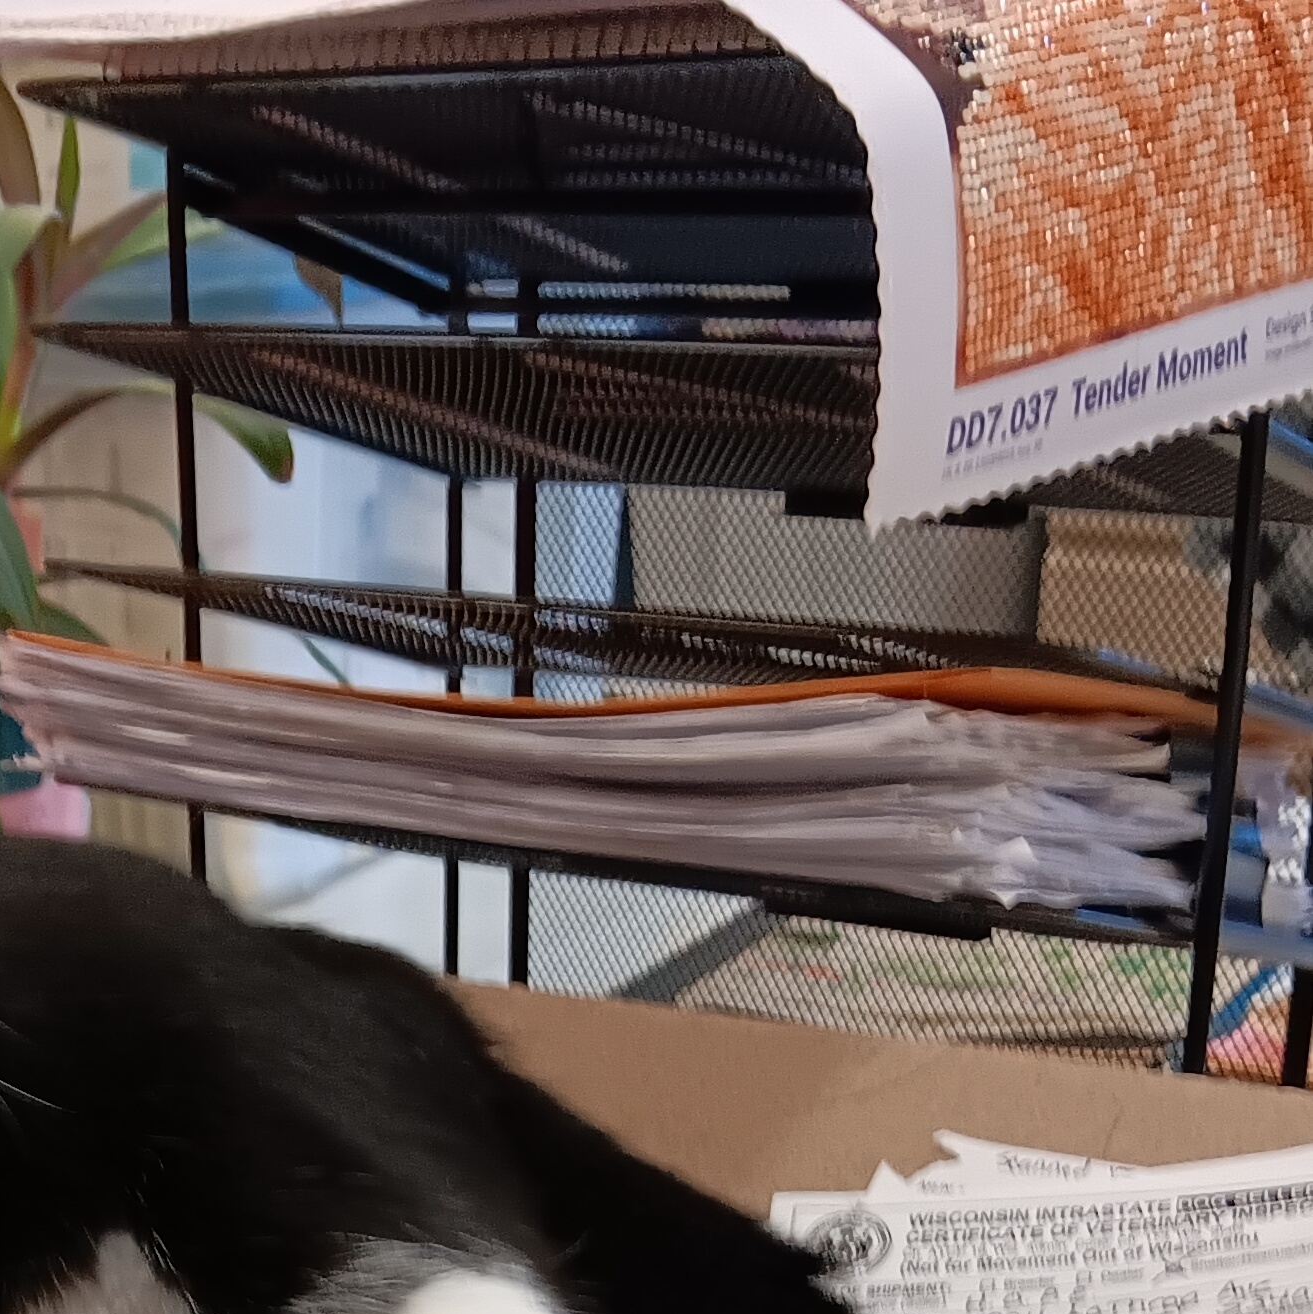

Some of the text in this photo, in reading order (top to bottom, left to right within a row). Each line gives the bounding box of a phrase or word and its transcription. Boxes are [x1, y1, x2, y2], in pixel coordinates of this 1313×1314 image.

[946, 327, 1249, 456] DD7.037 Tender Moment
[909, 1207, 1030, 1228] WISCONSIN
[1036, 1197, 1172, 1223] INTRASTATE
[906, 1225, 1044, 1246] CERTIFICATE
